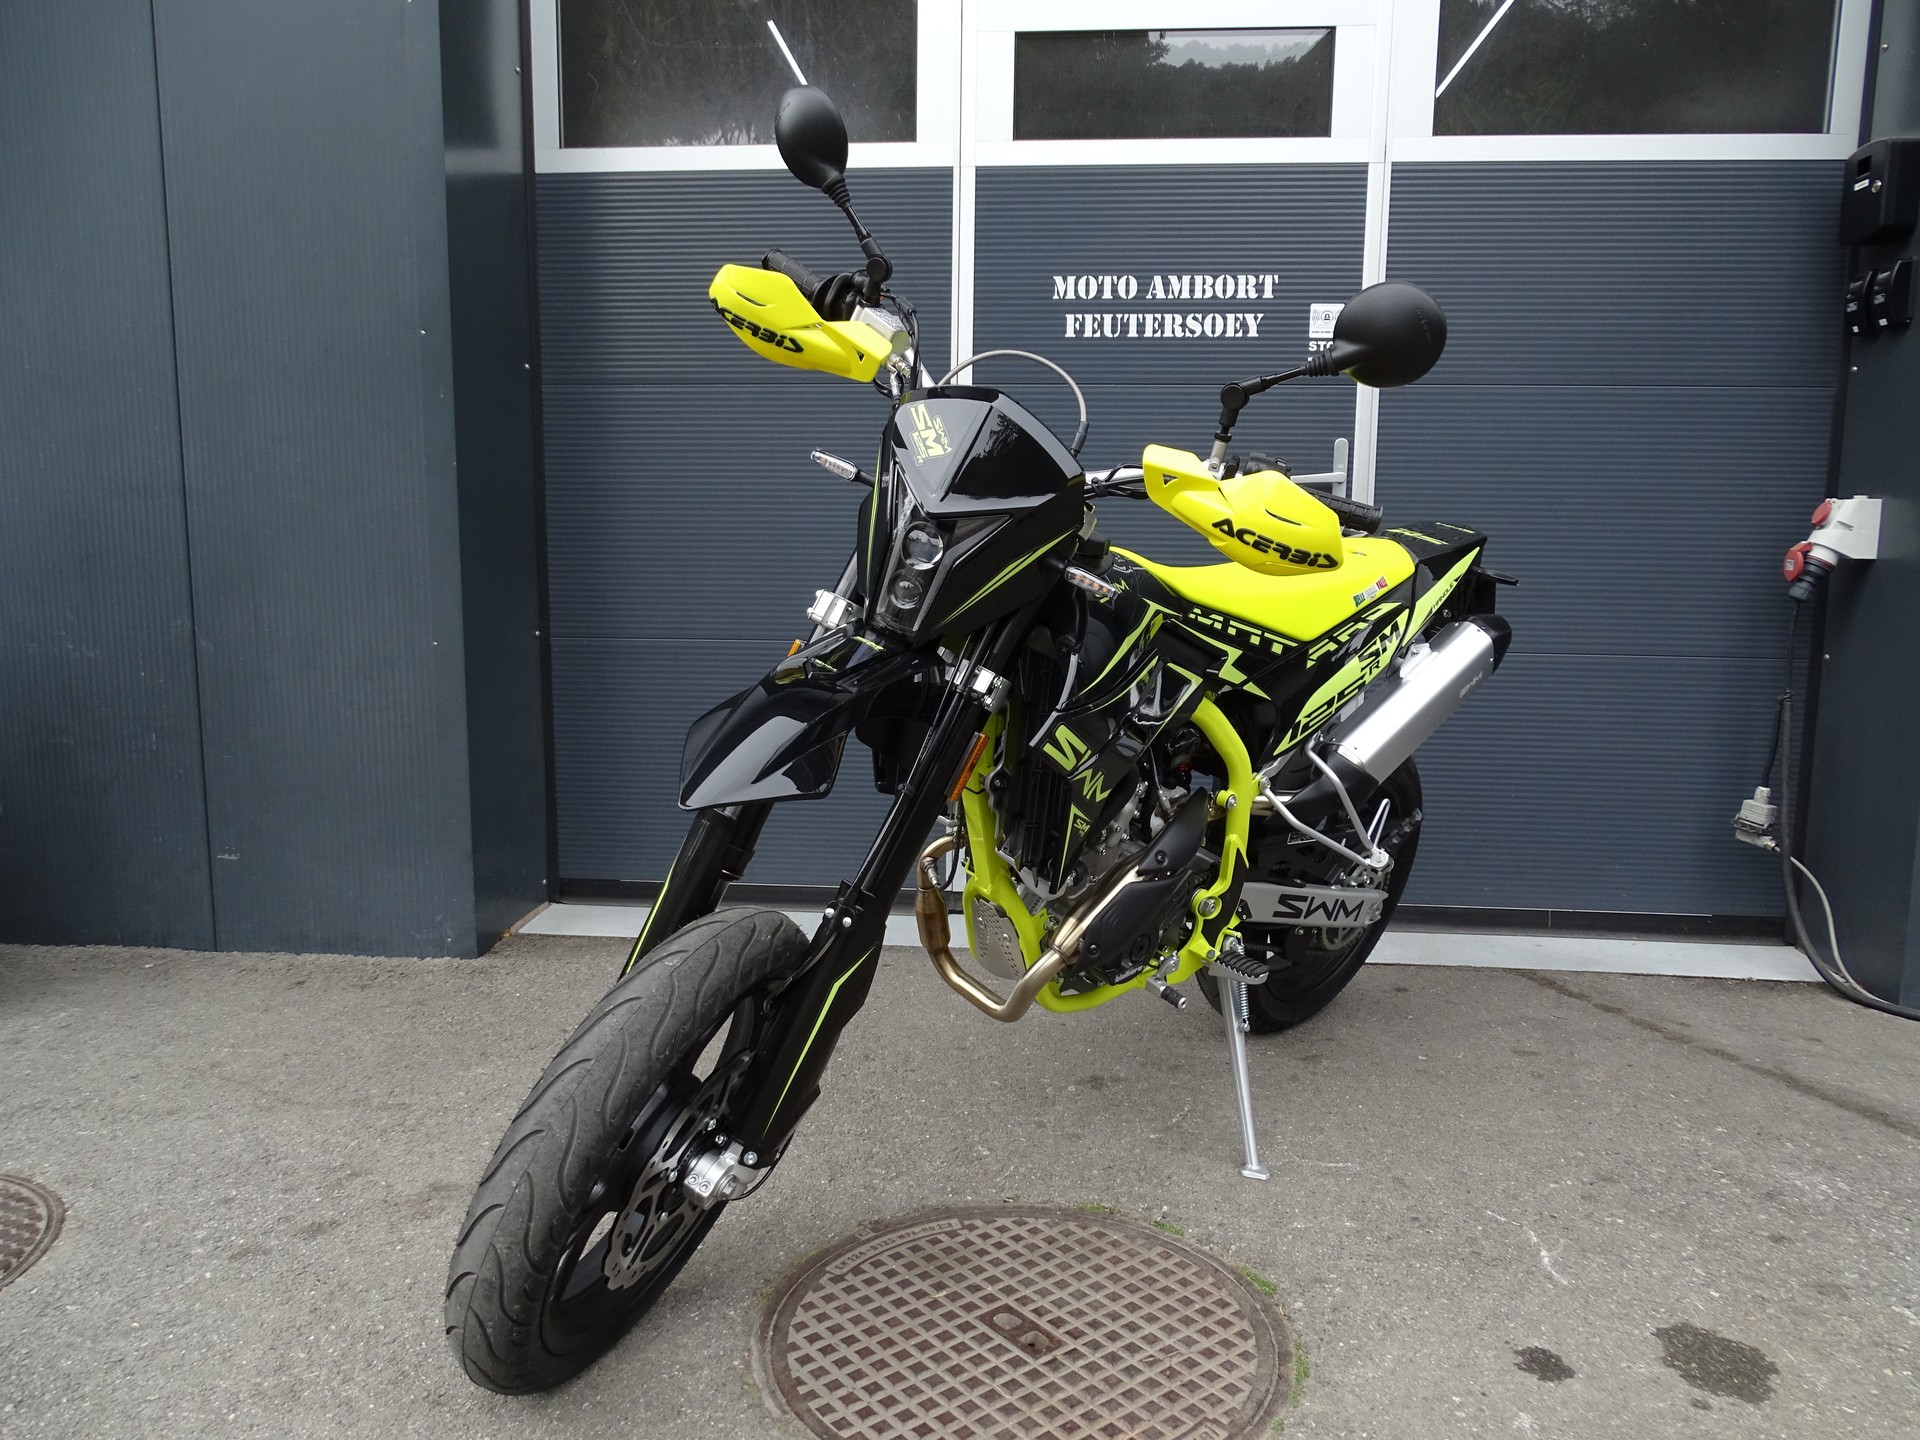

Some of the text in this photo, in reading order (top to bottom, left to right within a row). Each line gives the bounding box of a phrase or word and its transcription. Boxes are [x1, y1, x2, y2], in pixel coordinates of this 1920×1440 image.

[1052, 274, 1279, 300] MOTO AMBORT
[1064, 312, 1265, 338] FEUTERSOEY
[1210, 517, 1340, 569] ACERBIS
[1042, 724, 1113, 803] SWM
[1271, 893, 1365, 922] SWM
